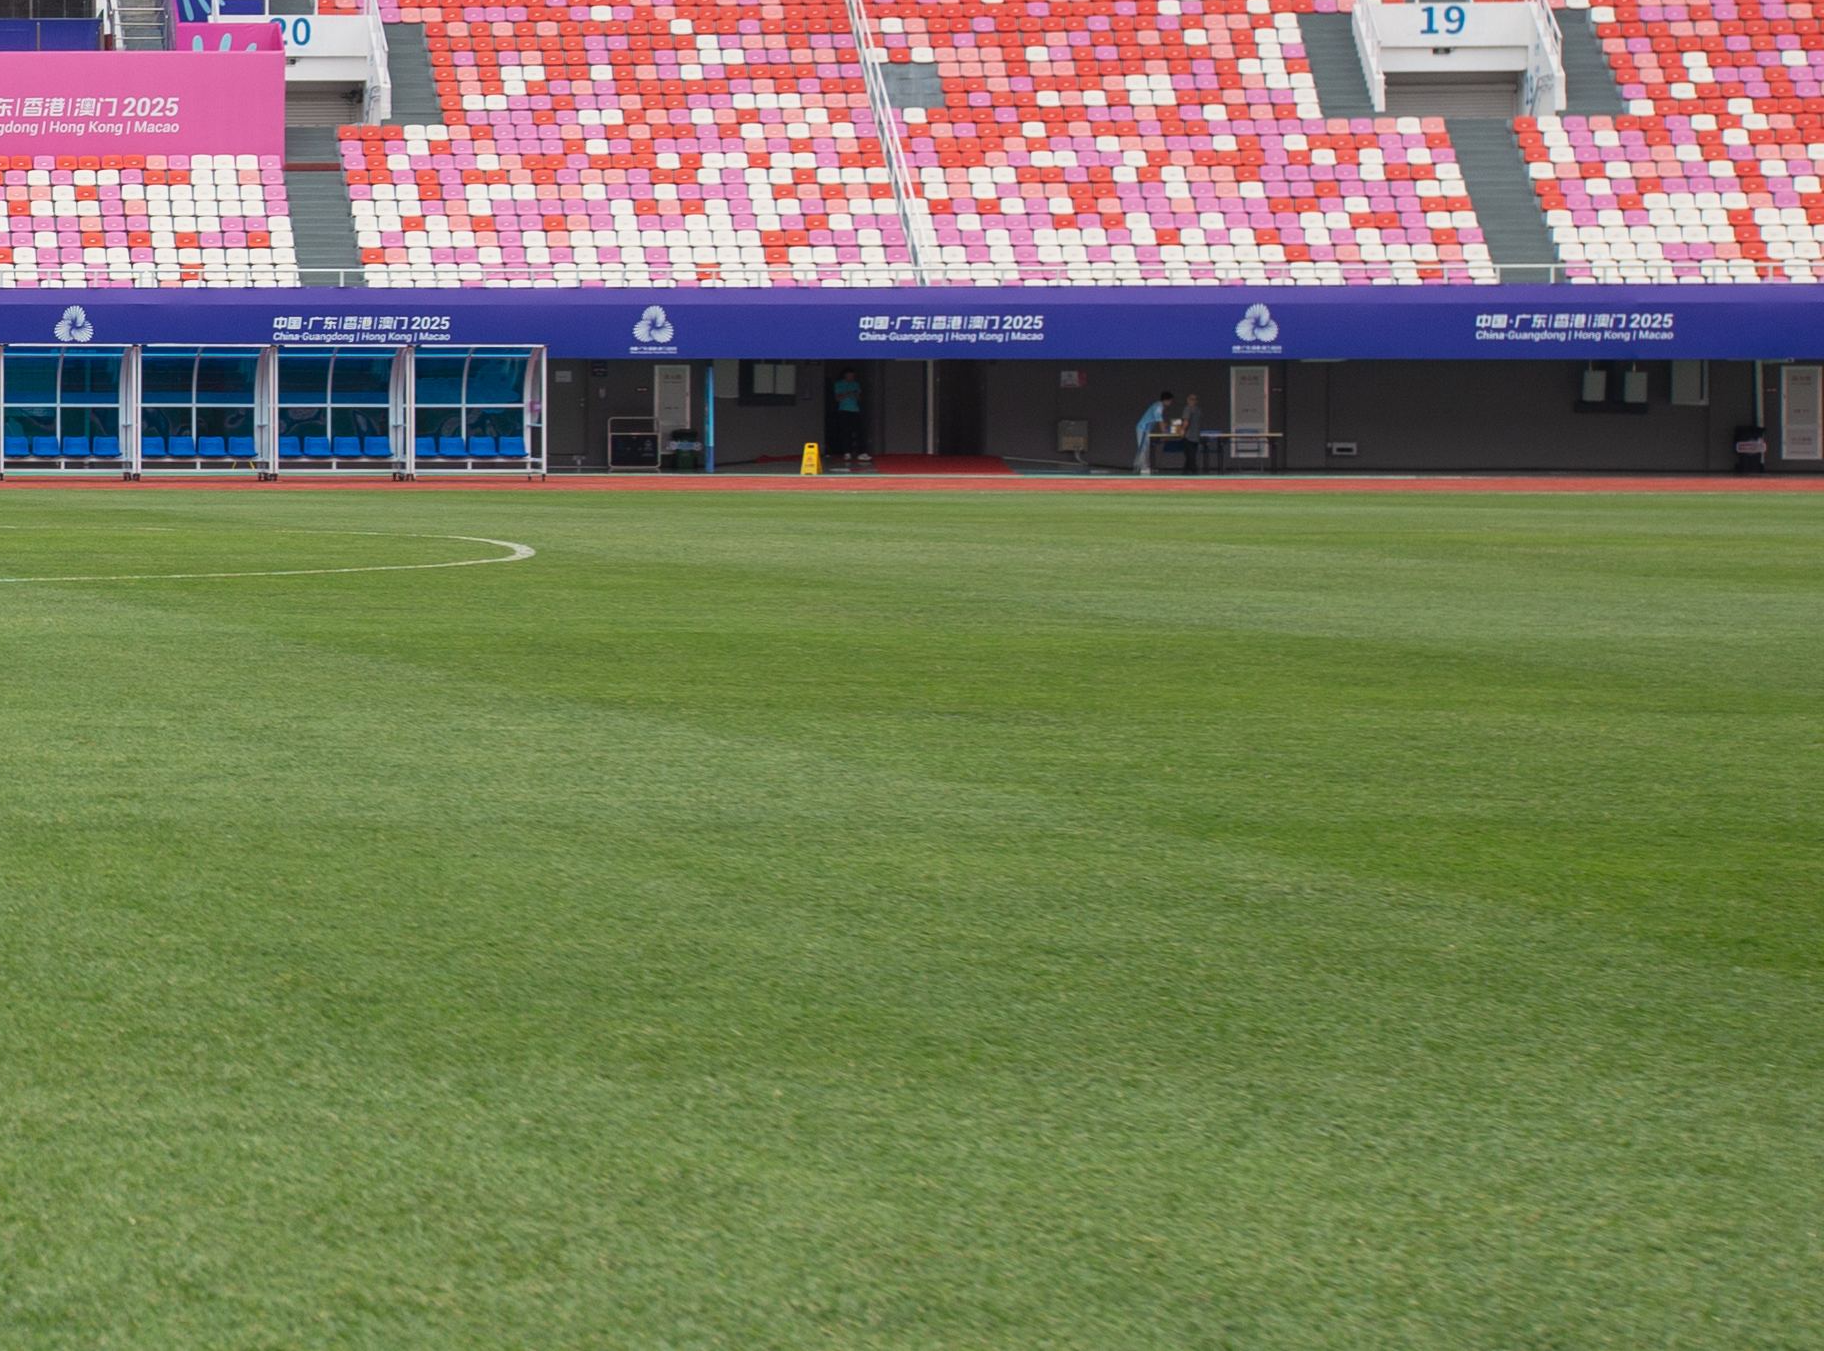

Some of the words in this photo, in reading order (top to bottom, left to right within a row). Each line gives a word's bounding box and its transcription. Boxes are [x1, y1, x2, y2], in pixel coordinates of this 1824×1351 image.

[1419, 5, 1466, 35] 19
[121, 97, 180, 116] 2025
[48, 121, 85, 135] Hong
[88, 121, 124, 135] Kong
[133, 121, 180, 132] Macao
[410, 317, 451, 329] 2025
[1002, 316, 1044, 329] 2025
[1629, 314, 1674, 328] 2025
[361, 333, 387, 342] Hong
[387, 333, 413, 342] Kong
[950, 333, 977, 342] Hong
[978, 333, 1004, 342] Kong
[1010, 332, 1044, 340] Macao
[1573, 331, 1602, 341] Hong
[1603, 331, 1631, 341] Kong
[1638, 331, 1674, 339] Macao
